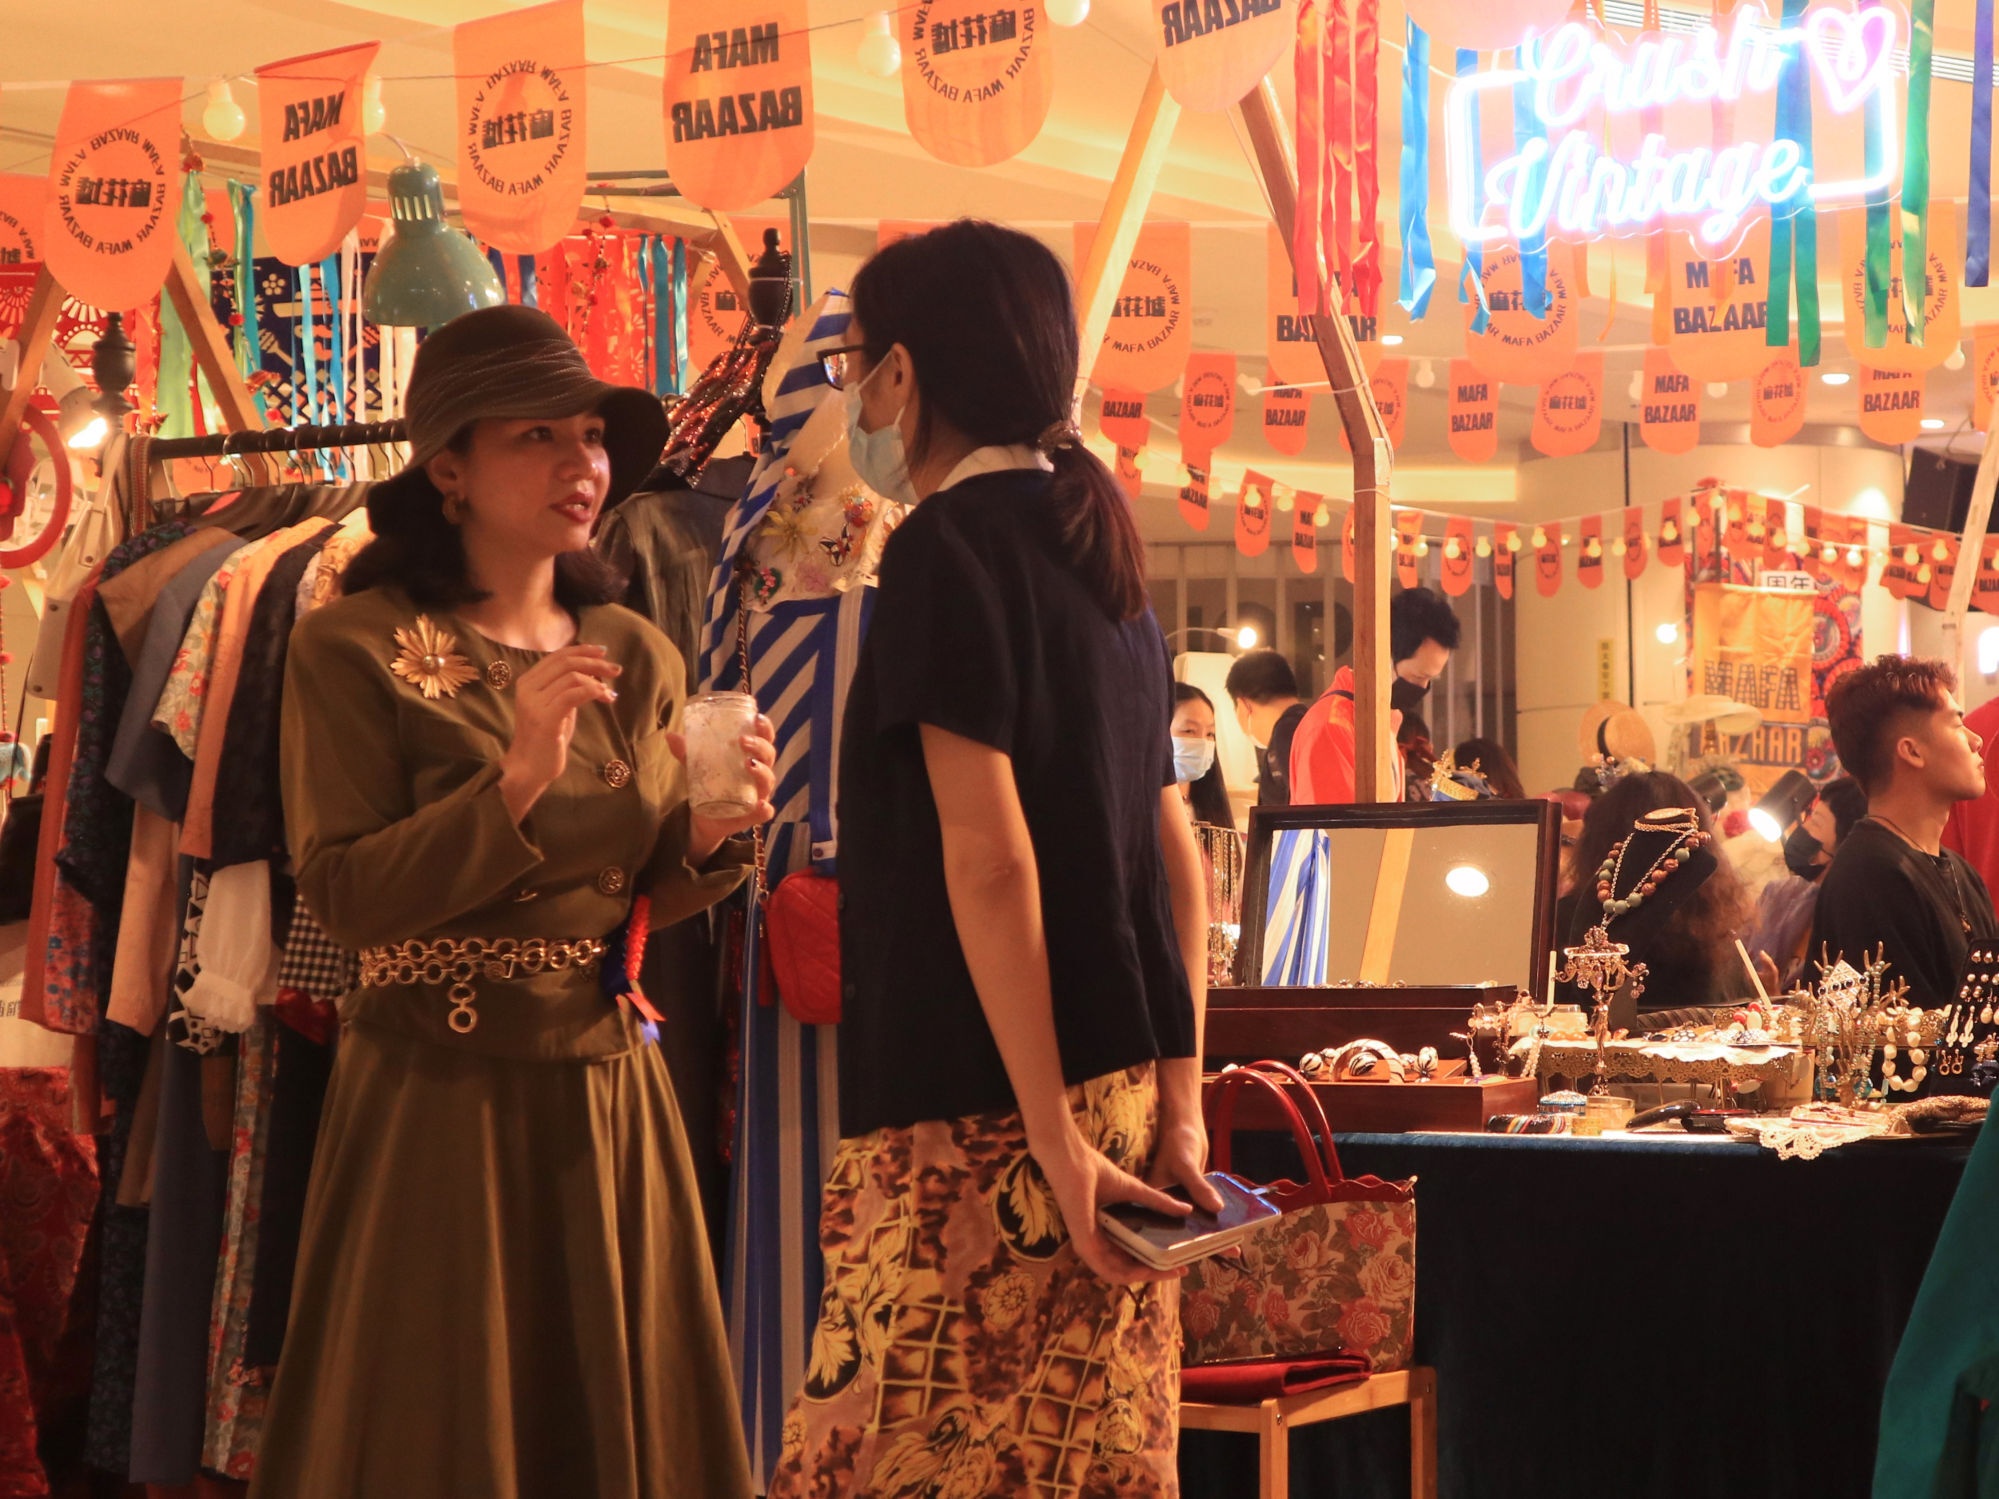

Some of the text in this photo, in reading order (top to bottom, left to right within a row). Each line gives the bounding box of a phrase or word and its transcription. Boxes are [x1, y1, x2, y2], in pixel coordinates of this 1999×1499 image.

[1522, 5, 1795, 127] Crush
[1485, 131, 1812, 243] Vintage
[1130, 259, 1162, 276] BAZA
[1685, 258, 1755, 288] MA
[1489, 290, 1552, 311] 麻花
[1924, 288, 1948, 326] AZAAR
[701, 292, 725, 336] BAZAAR
[1502, 335, 1533, 346] MAFA
[1535, 305, 1567, 343] BAZAAR
[1147, 310, 1180, 350] BAZAAR
[1276, 315, 1377, 342] BAAR
[1112, 340, 1145, 353] MAFA
[1457, 384, 1488, 403] MAFA
[1655, 374, 1689, 394] MAFA
[1103, 401, 1142, 418] BAZAAR
[1645, 403, 1696, 423] BAZAAR
[1864, 390, 1920, 413] BAZAAR
[1265, 409, 1306, 426] BAZAAR
[1452, 412, 1493, 433] BAZAAR
[1704, 659, 1801, 711] MAFA
[1702, 719, 1801, 765] AZAAR
